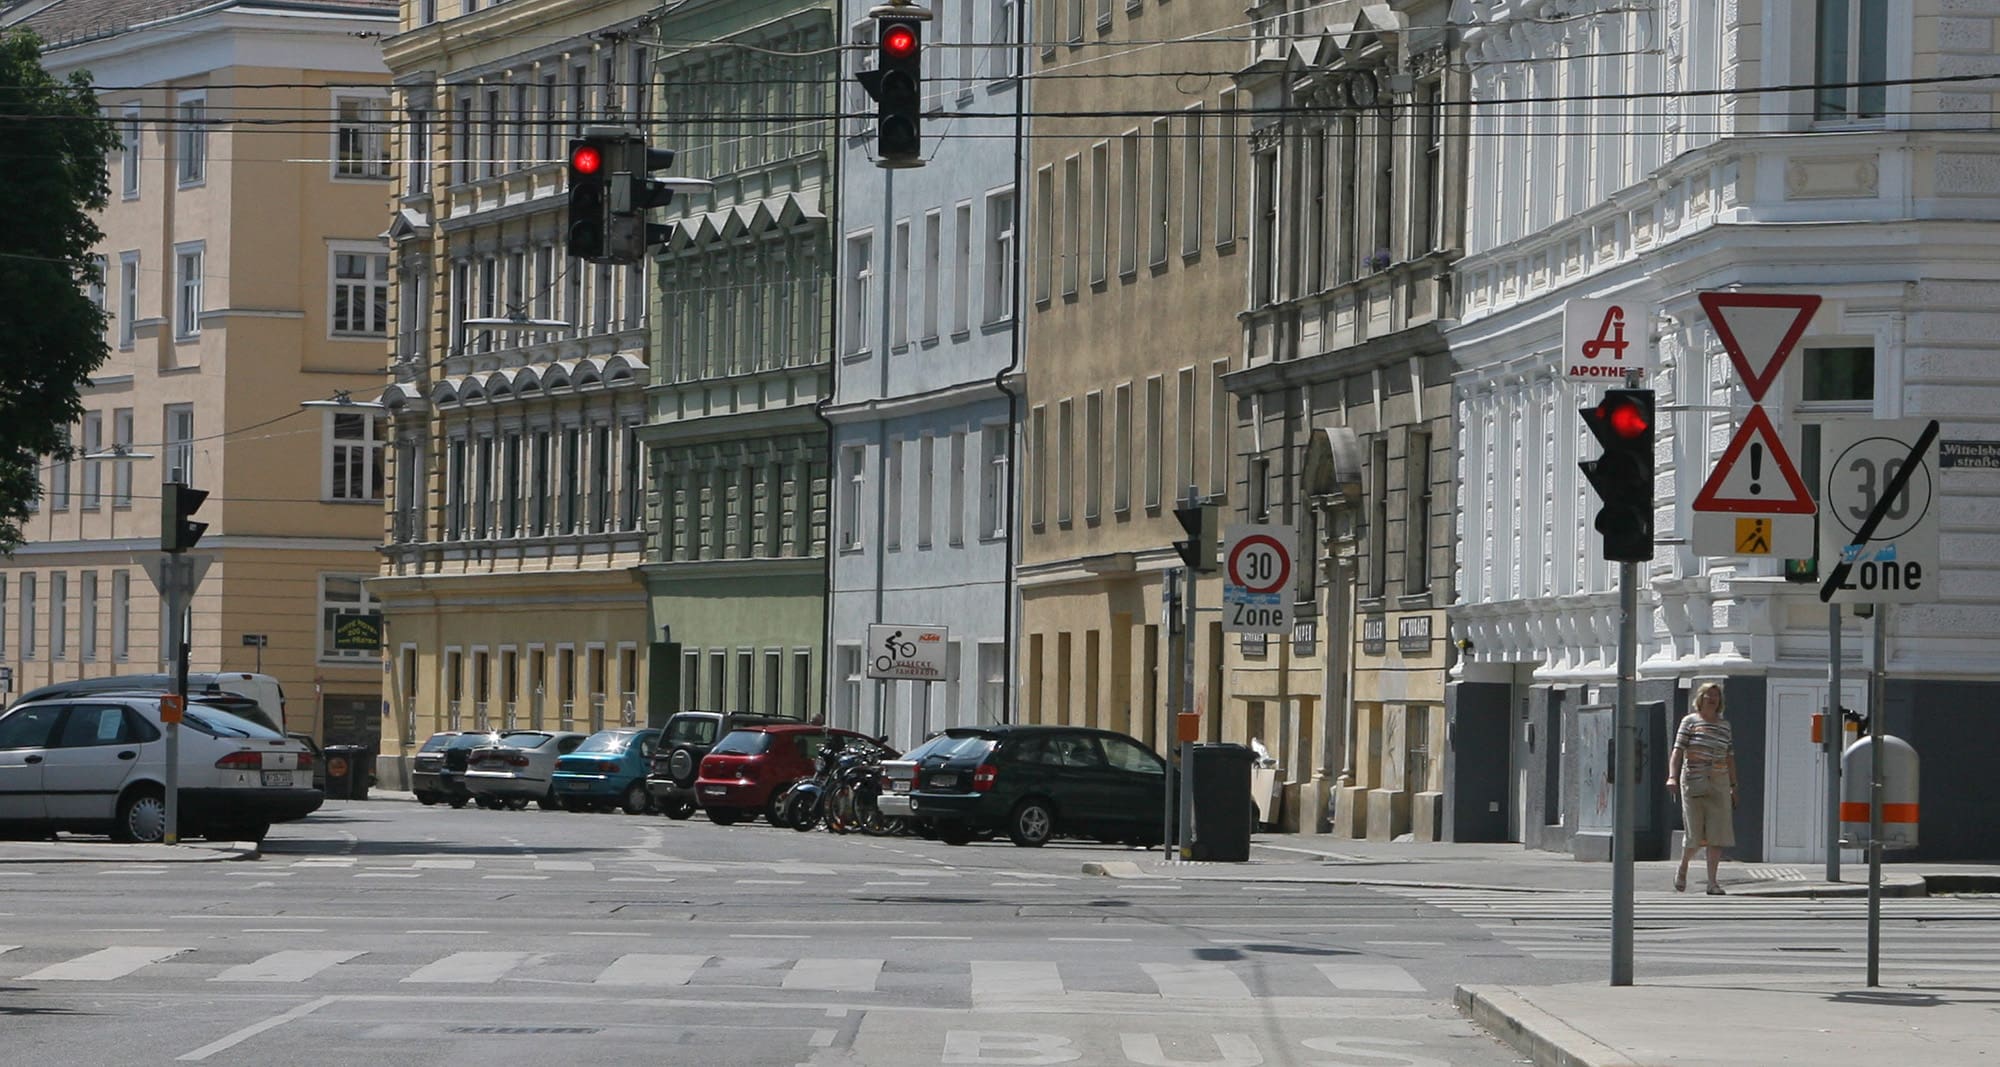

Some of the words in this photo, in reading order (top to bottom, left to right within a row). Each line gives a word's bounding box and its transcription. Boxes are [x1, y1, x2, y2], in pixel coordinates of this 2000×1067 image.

[1569, 366, 1644, 378] APOTHEE
[1848, 457, 1911, 520] 30
[1246, 552, 1272, 580] 30
[1233, 602, 1283, 626] Zone
[942, 1030, 1450, 1067] BUS
